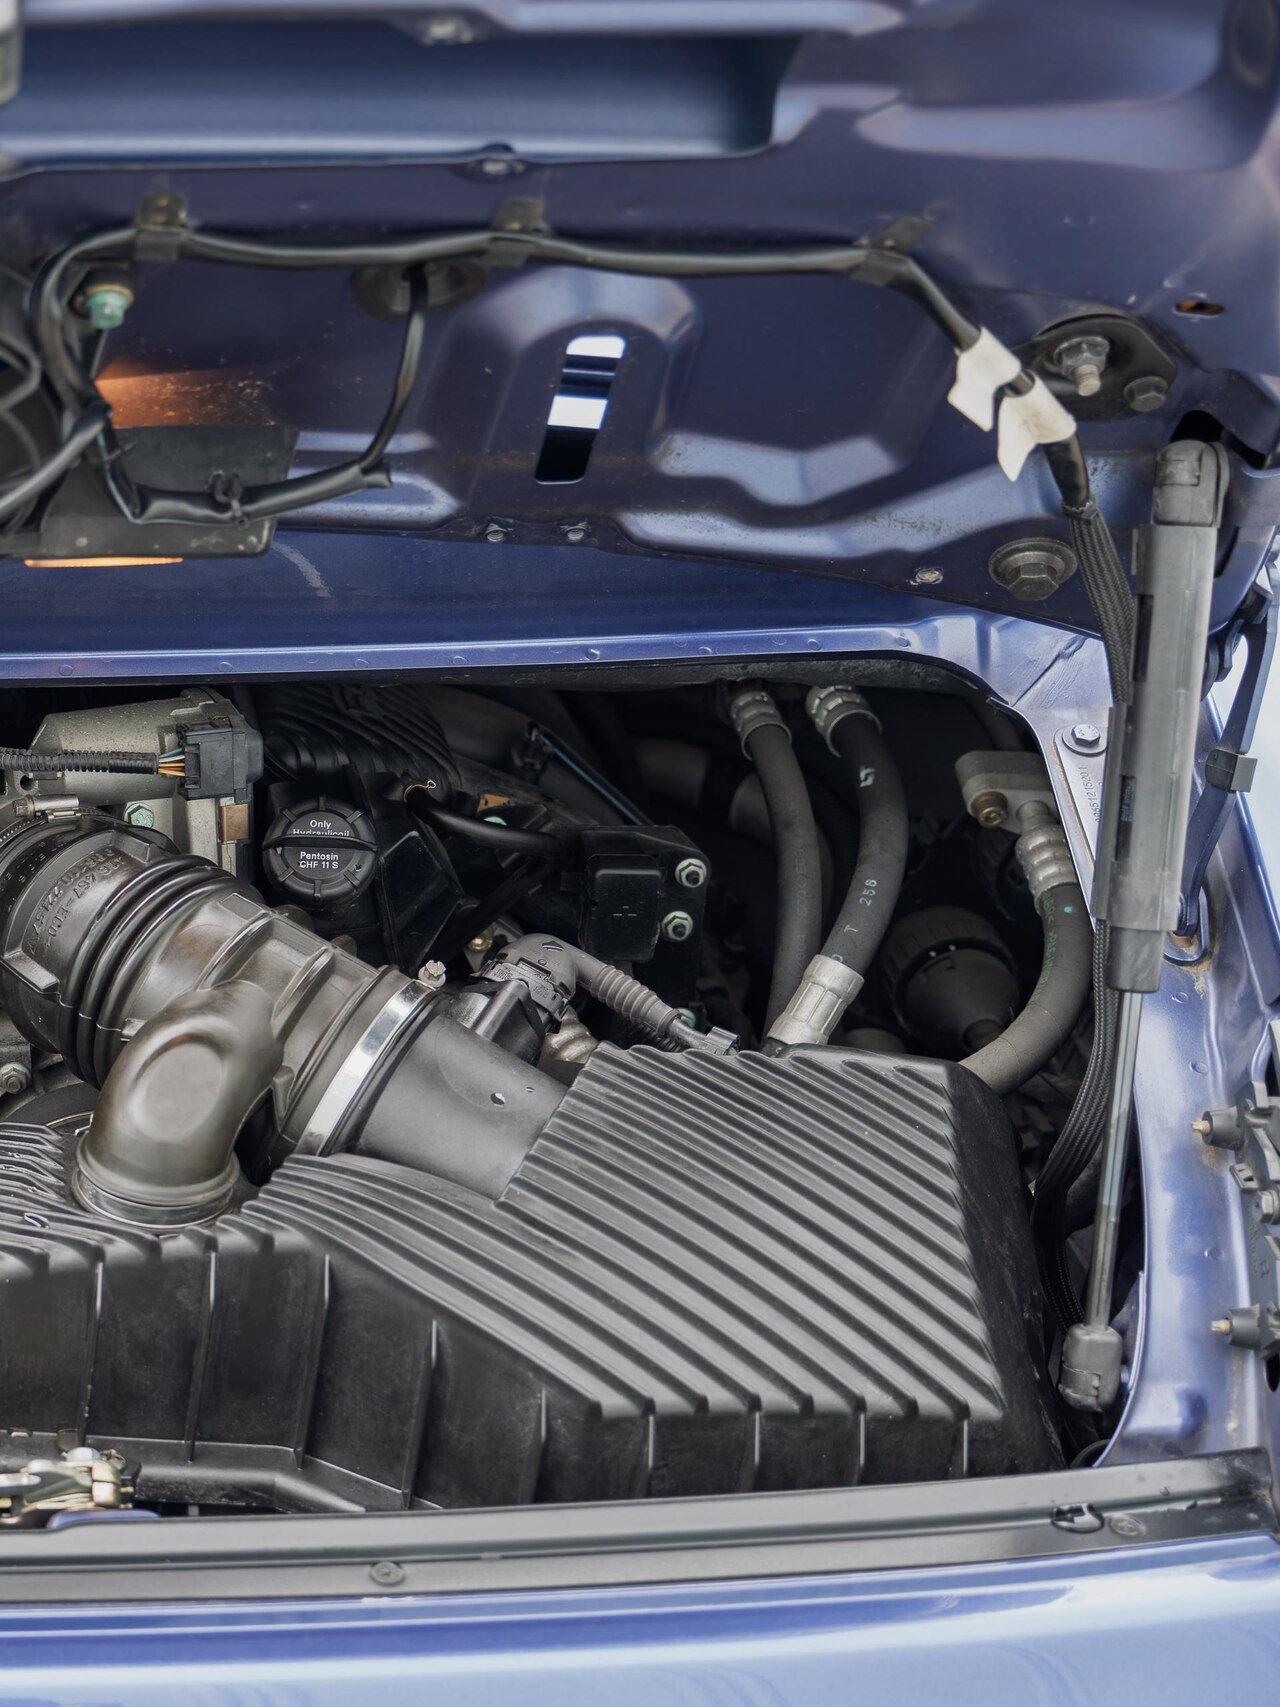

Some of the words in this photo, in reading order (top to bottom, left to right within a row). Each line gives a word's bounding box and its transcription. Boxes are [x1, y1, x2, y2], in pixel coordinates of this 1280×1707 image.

[309, 819, 332, 829] Only
[299, 851, 339, 861] Pentosin
[299, 860, 319, 869] CHF
[321, 860, 330, 869] 11
[331, 860, 339, 869] S
[858, 879, 878, 907] 256
